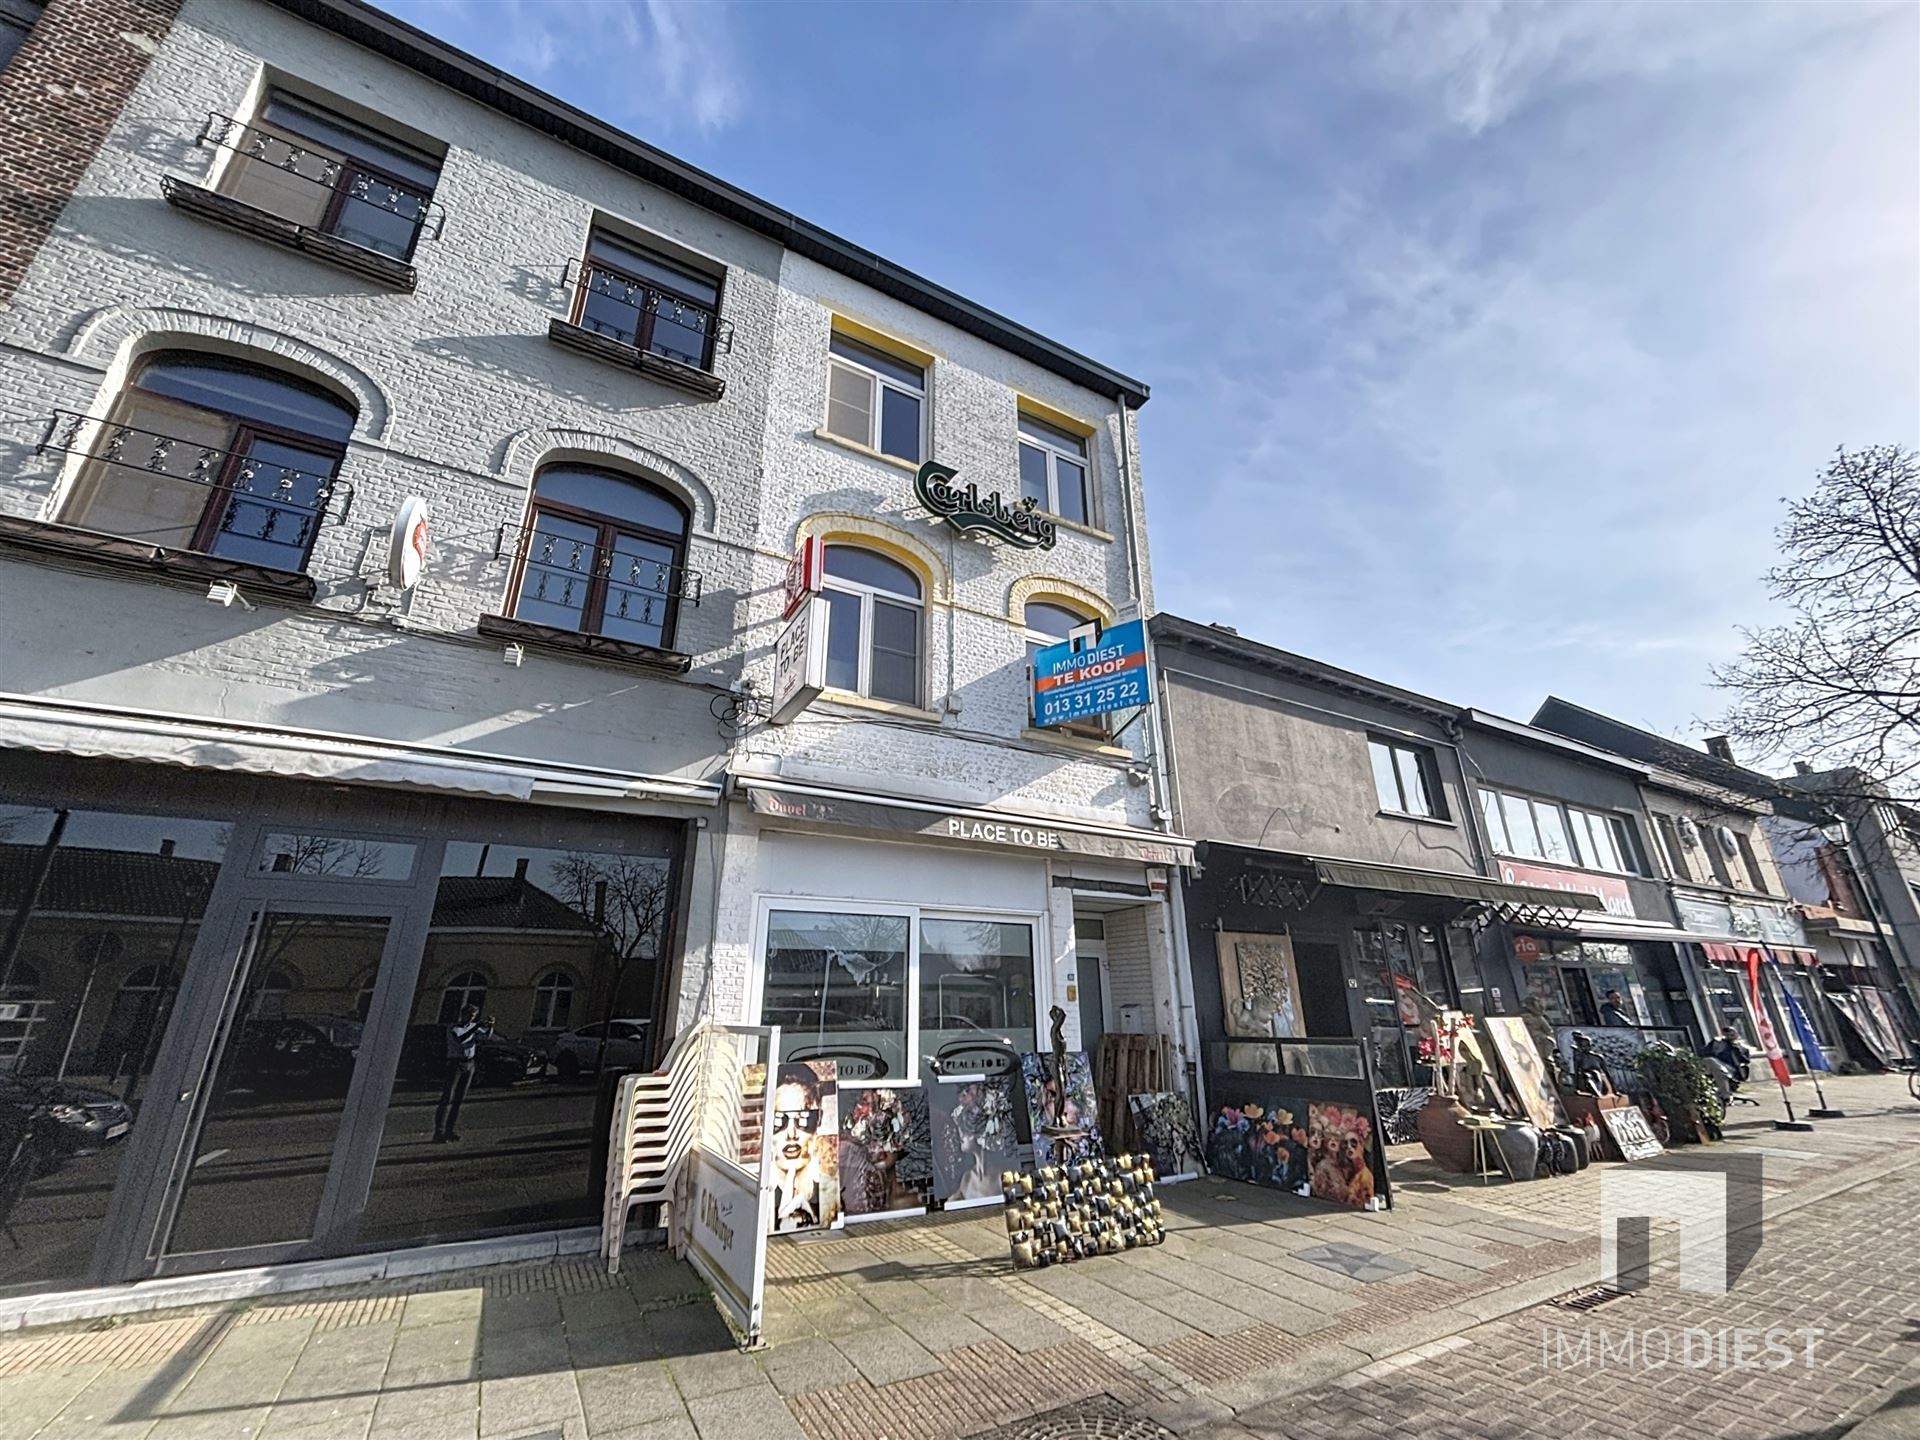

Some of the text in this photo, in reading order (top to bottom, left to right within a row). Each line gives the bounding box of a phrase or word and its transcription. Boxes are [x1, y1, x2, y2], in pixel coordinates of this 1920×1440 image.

[913, 461, 1057, 551] Carlsberg
[780, 617, 806, 660] PLACE
[779, 658, 790, 678] TO
[793, 637, 805, 664] BE
[1053, 644, 1124, 674] IMMO DIEST
[1054, 658, 1126, 687] TE KOOP
[1044, 682, 1139, 716] 013 31 25 22
[768, 794, 806, 816] Duvel
[948, 819, 1058, 849] PLACE TO BE
[1515, 939, 1537, 953] ria
[839, 1064, 872, 1076] TO BE
